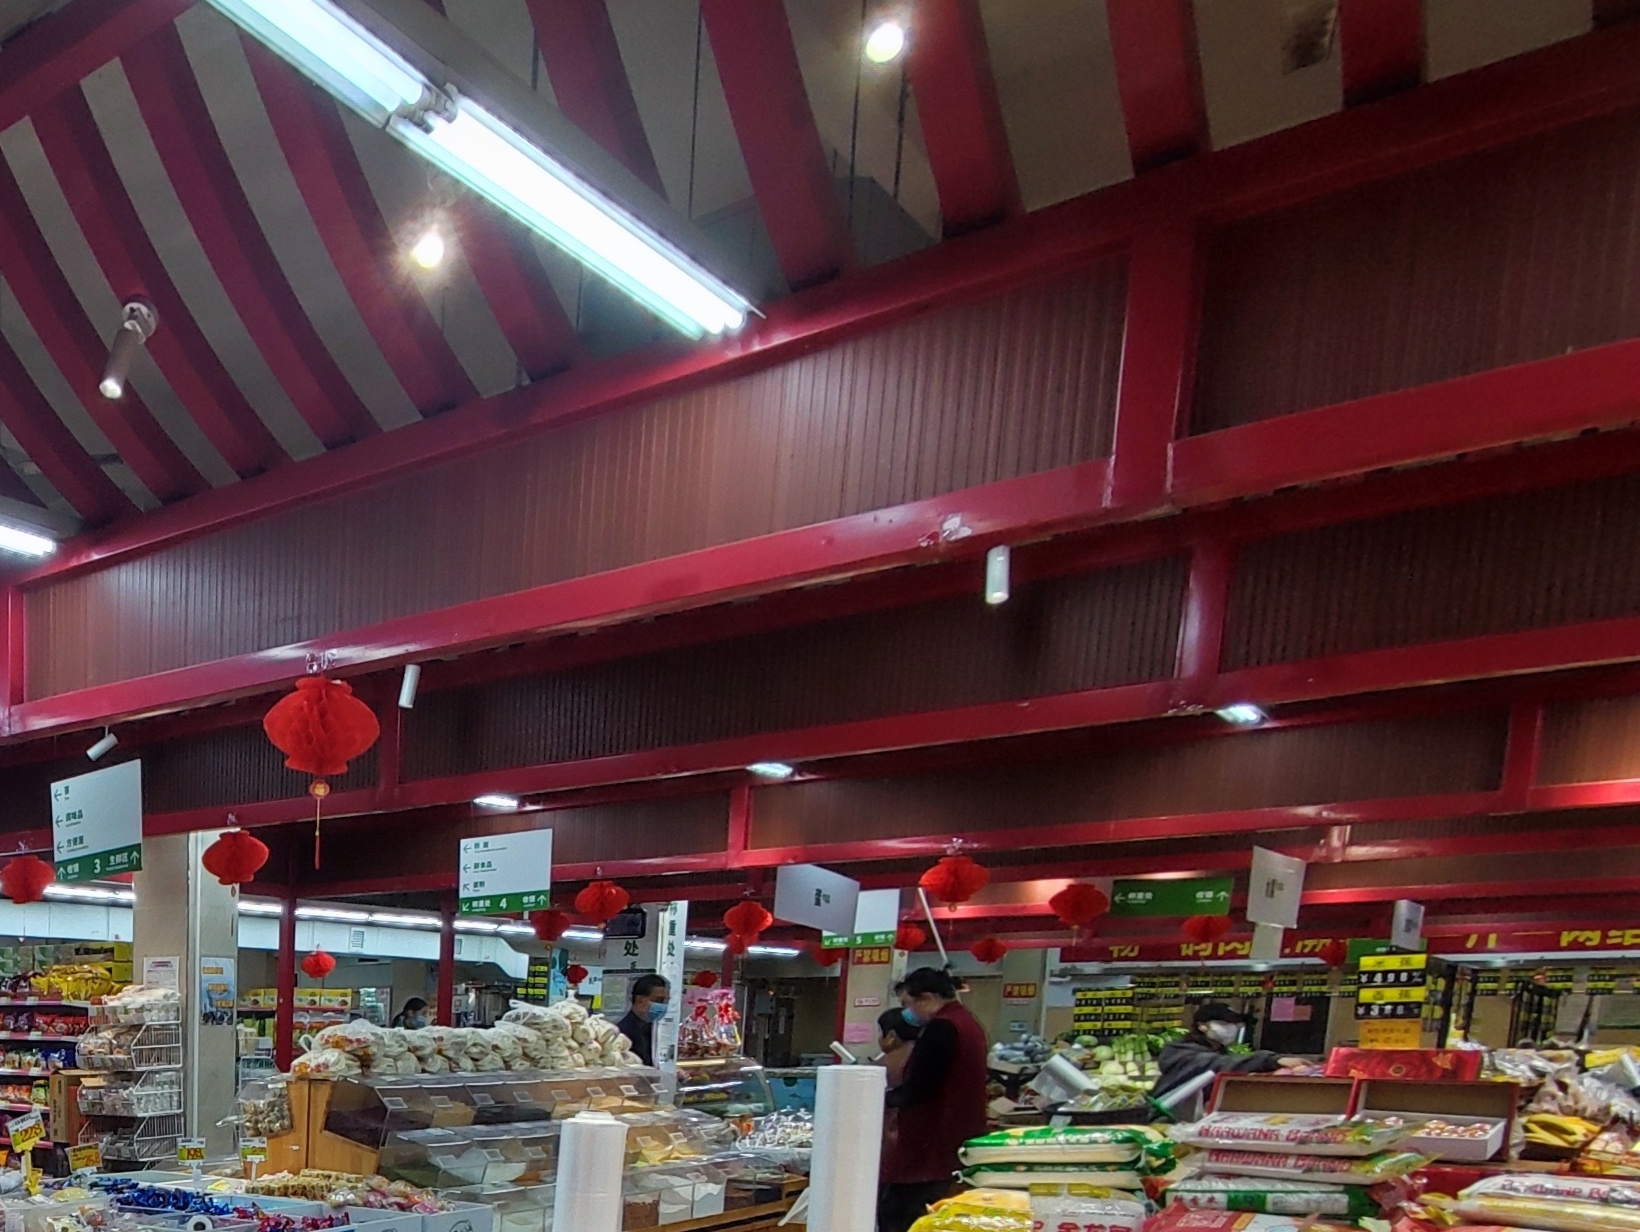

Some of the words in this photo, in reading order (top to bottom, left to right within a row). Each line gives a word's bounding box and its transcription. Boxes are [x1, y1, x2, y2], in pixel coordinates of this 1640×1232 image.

[94, 859, 100, 873] 3
[499, 898, 507, 909] 4
[623, 940, 640, 957] 处
